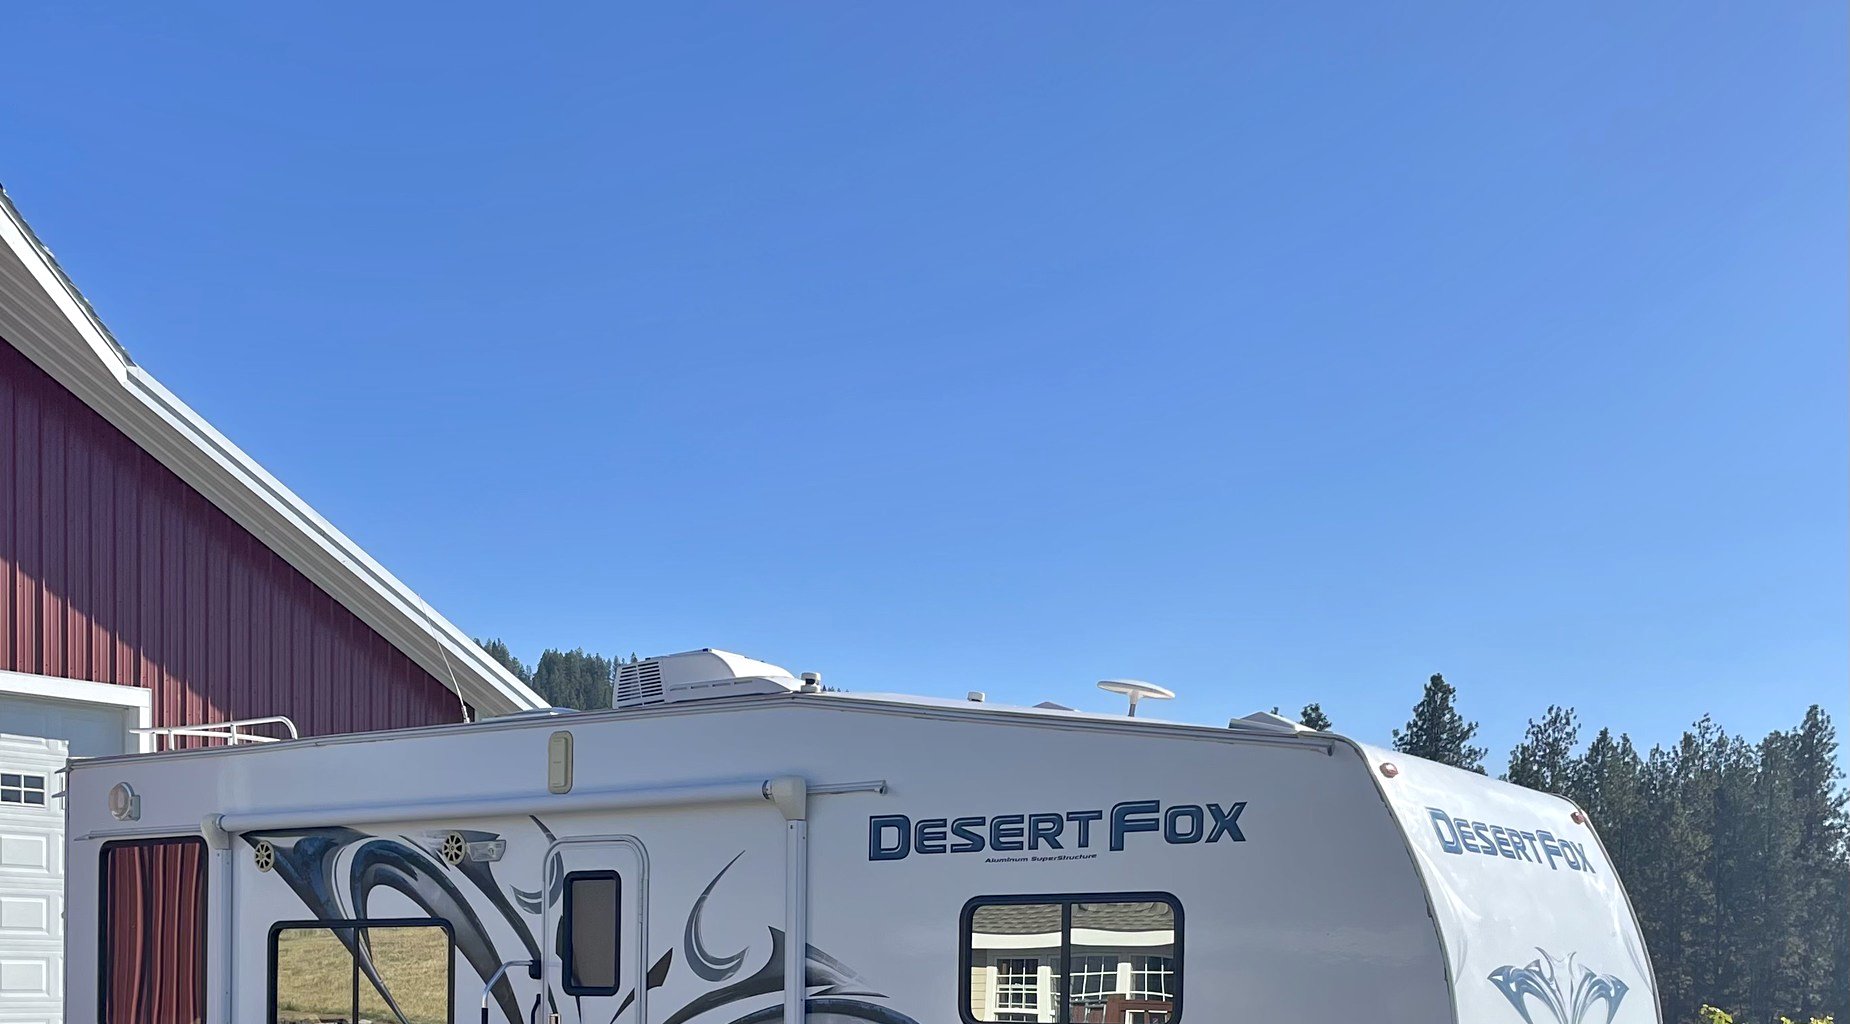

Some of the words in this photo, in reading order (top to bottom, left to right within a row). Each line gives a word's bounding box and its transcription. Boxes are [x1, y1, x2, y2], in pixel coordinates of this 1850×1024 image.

[869, 810, 1103, 861] DESERT
[1109, 800, 1248, 851] FOX
[1031, 854, 1097, 863] SuperStructure
